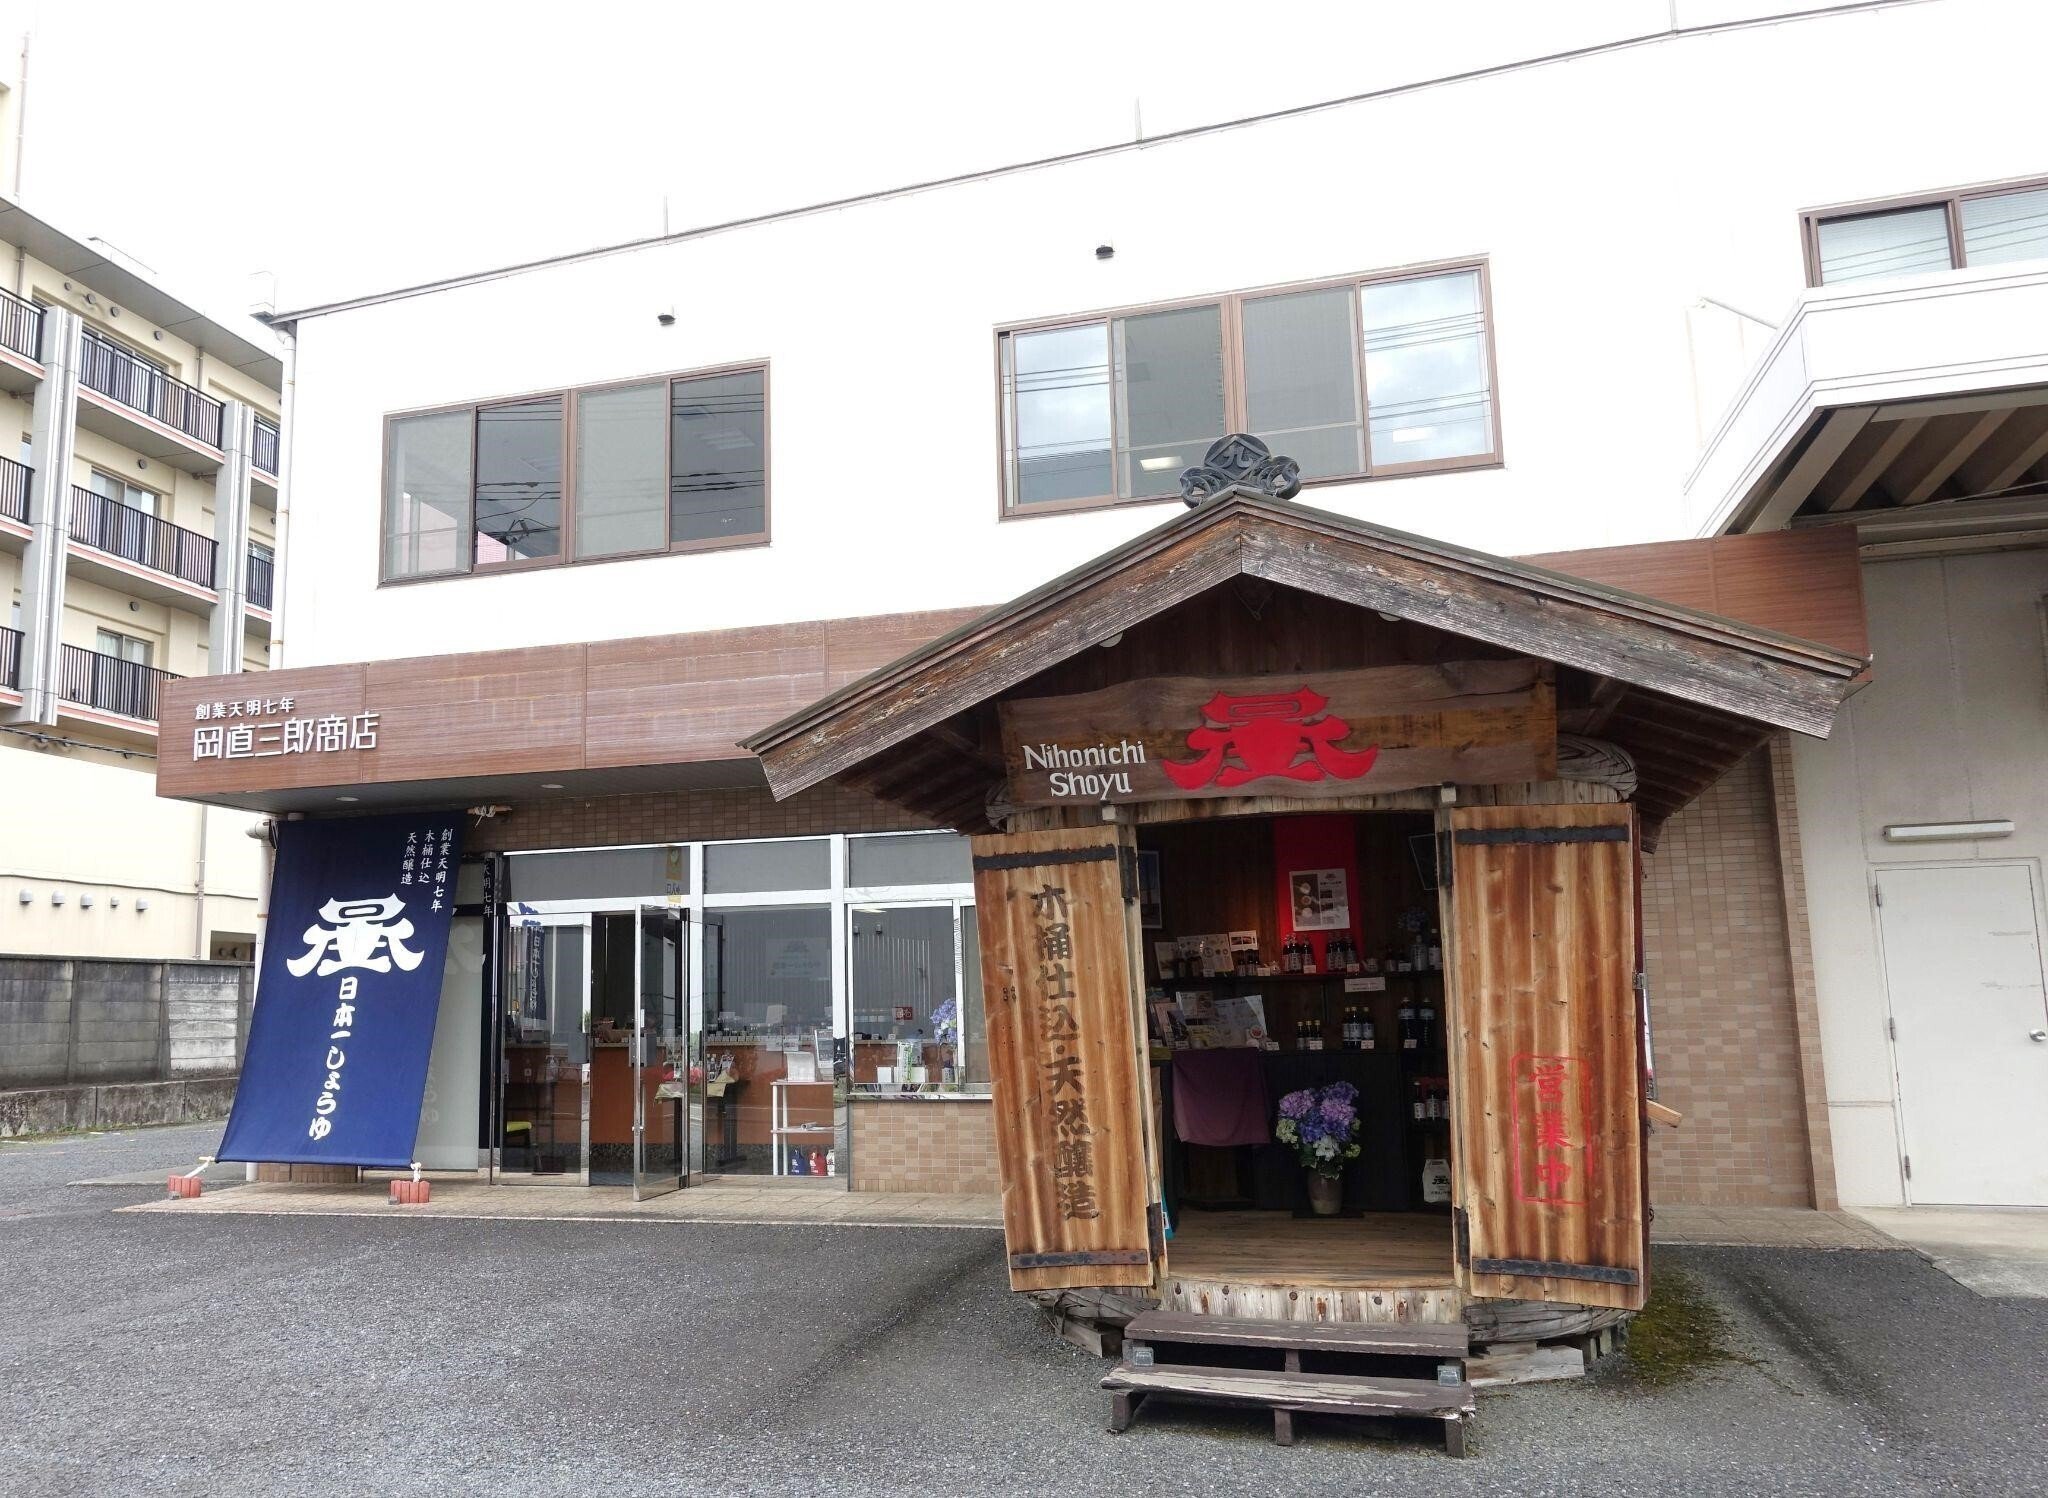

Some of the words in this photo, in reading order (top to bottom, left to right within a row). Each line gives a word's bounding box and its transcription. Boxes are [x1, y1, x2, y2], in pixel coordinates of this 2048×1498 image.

[195, 696, 295, 721] 創業天明七年
[192, 711, 380, 761] 岡直三郎商店
[1022, 738, 1147, 771] Nihonichi
[1049, 770, 1133, 800] Shoyu
[417, 829, 436, 884] 木桶仕込
[430, 828, 454, 913] 創業天明七年
[308, 976, 359, 1142] 日本一しょうゆ
[1528, 1063, 1575, 1201] 営業中
